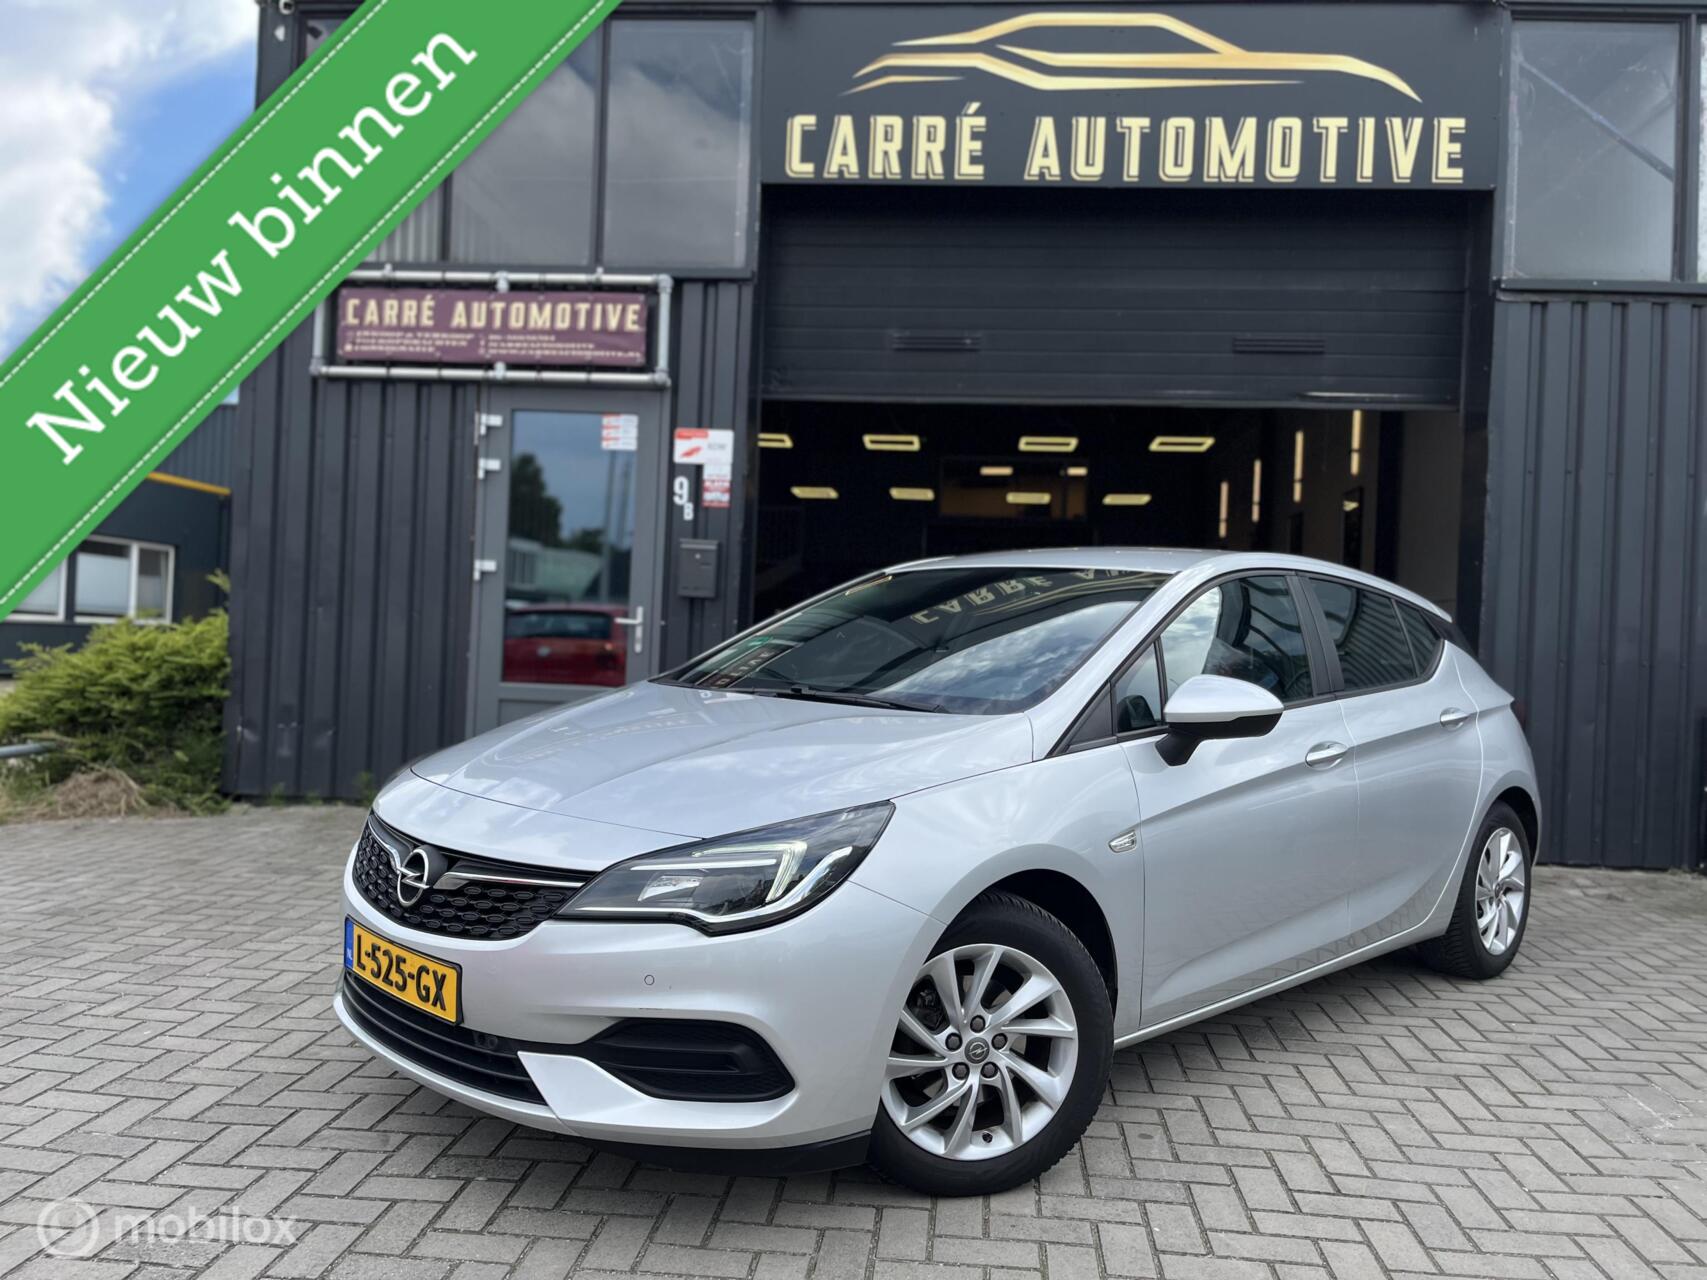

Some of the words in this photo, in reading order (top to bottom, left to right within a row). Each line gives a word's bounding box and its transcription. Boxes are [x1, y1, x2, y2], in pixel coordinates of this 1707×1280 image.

[785, 102, 987, 180] CARRÉ
[1024, 116, 1466, 183] AUTOMOTIVE
[346, 295, 435, 326] CARRÉ
[450, 301, 641, 331] AUTOMOTIVE
[357, 934, 447, 1012] L-525-GX
